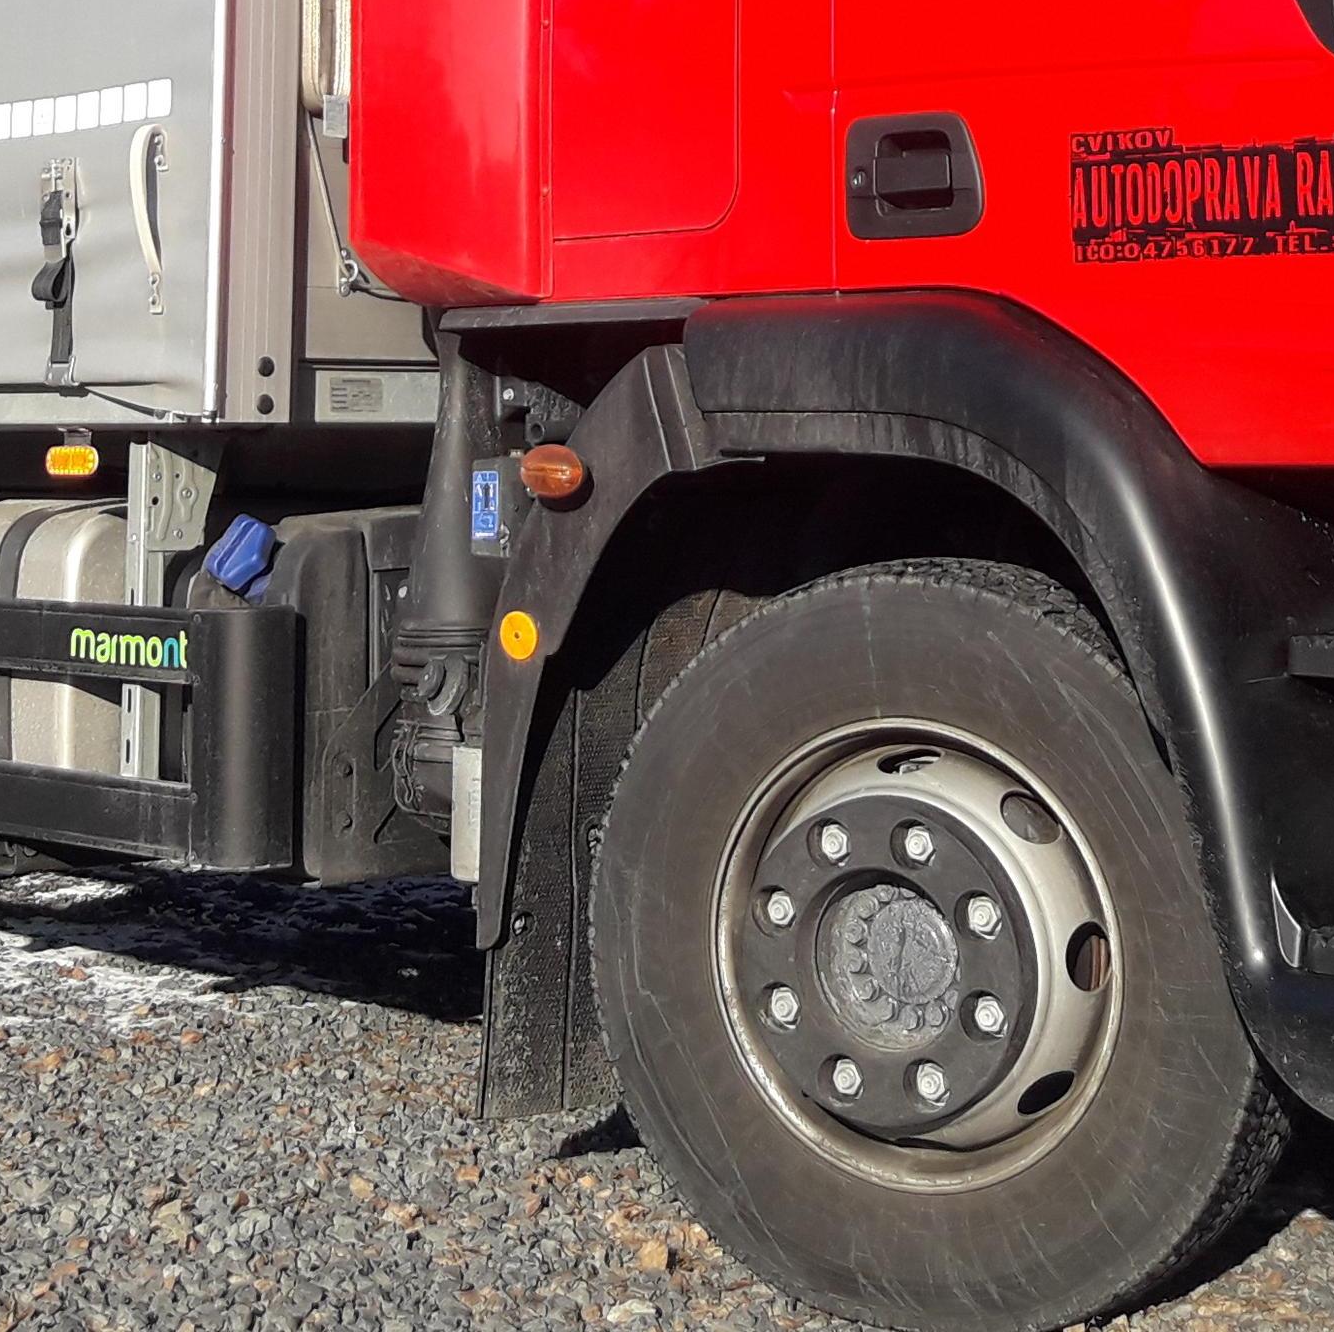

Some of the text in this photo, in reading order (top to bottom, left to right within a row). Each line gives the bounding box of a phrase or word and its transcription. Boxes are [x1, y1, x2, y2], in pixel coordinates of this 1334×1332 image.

[1071, 129, 1171, 154] CVIKOV
[1073, 153, 1282, 229] AUTODOPRAVA
[70, 628, 188, 669] marmont
